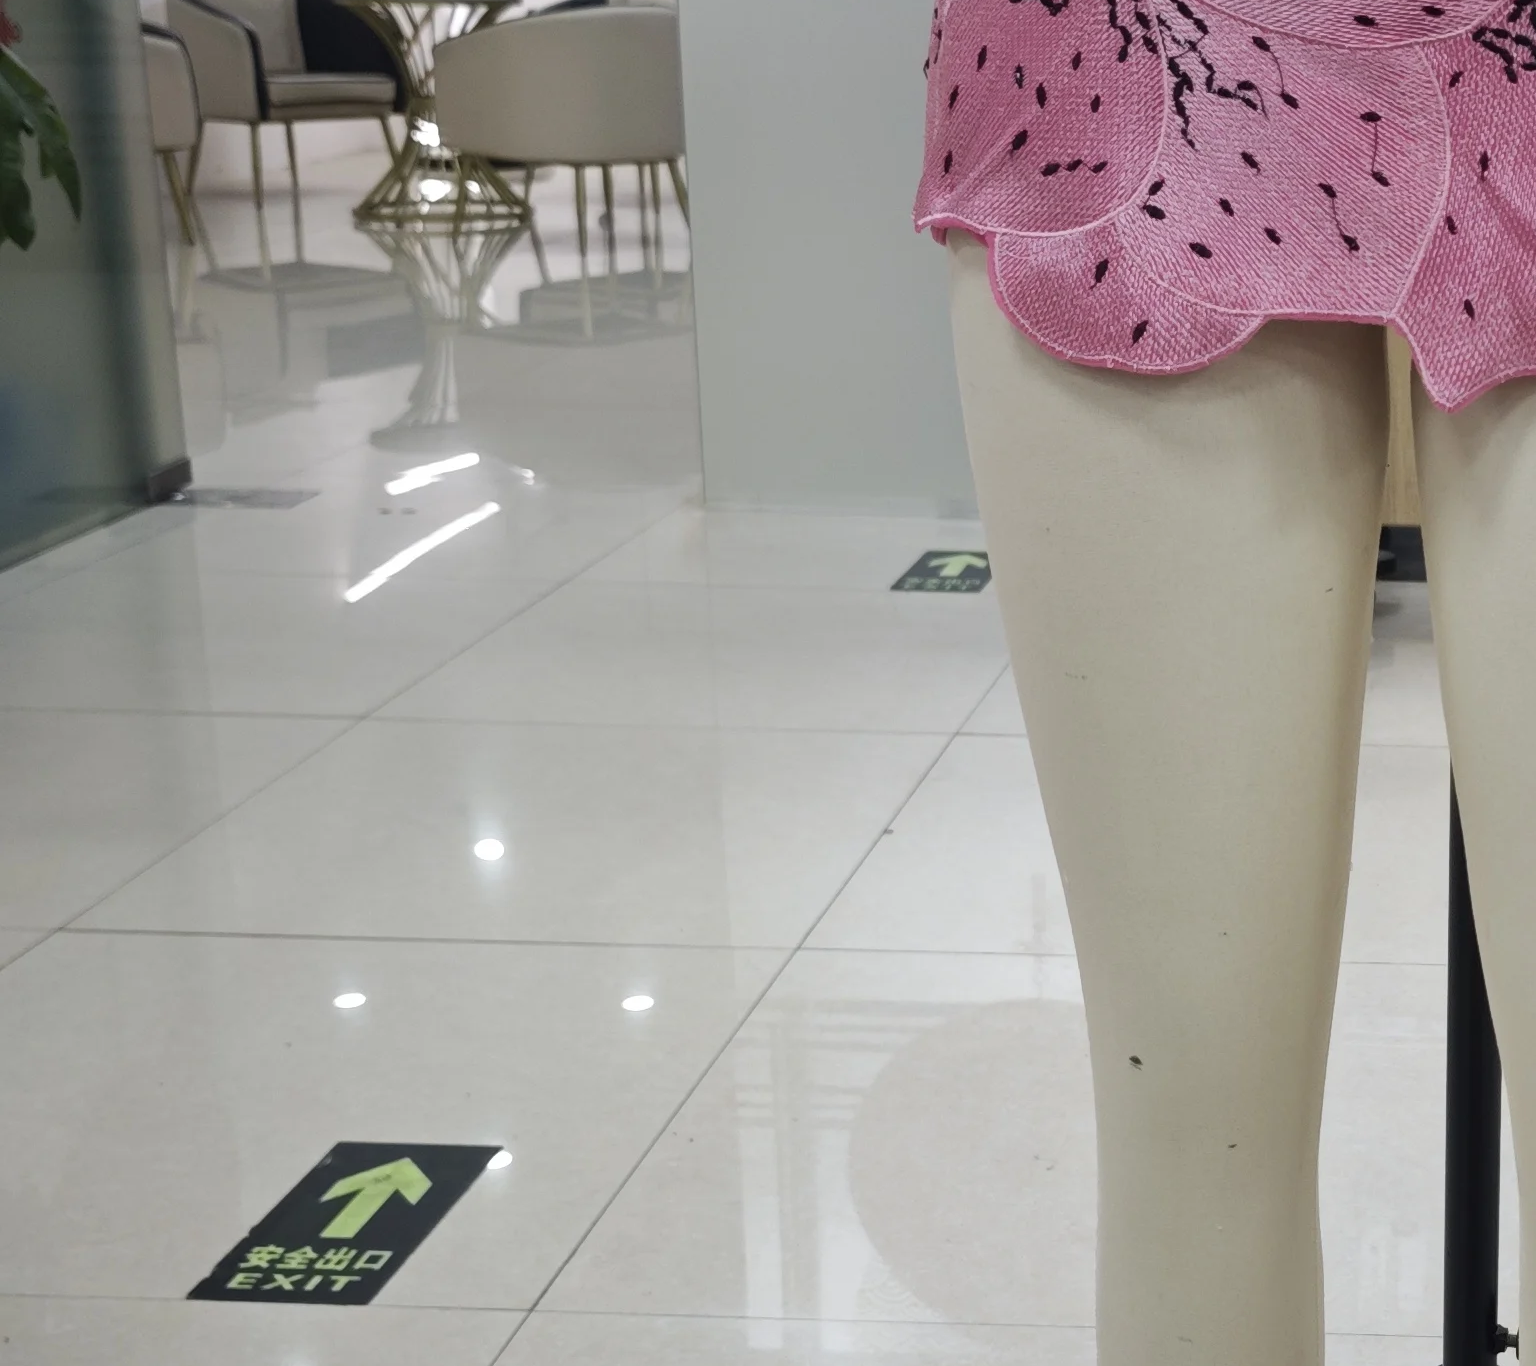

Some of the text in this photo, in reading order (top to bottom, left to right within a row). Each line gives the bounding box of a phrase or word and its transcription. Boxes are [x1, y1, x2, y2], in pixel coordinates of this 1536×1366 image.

[239, 1244, 393, 1271] 安全出口
[226, 1272, 362, 1293] EXIT
